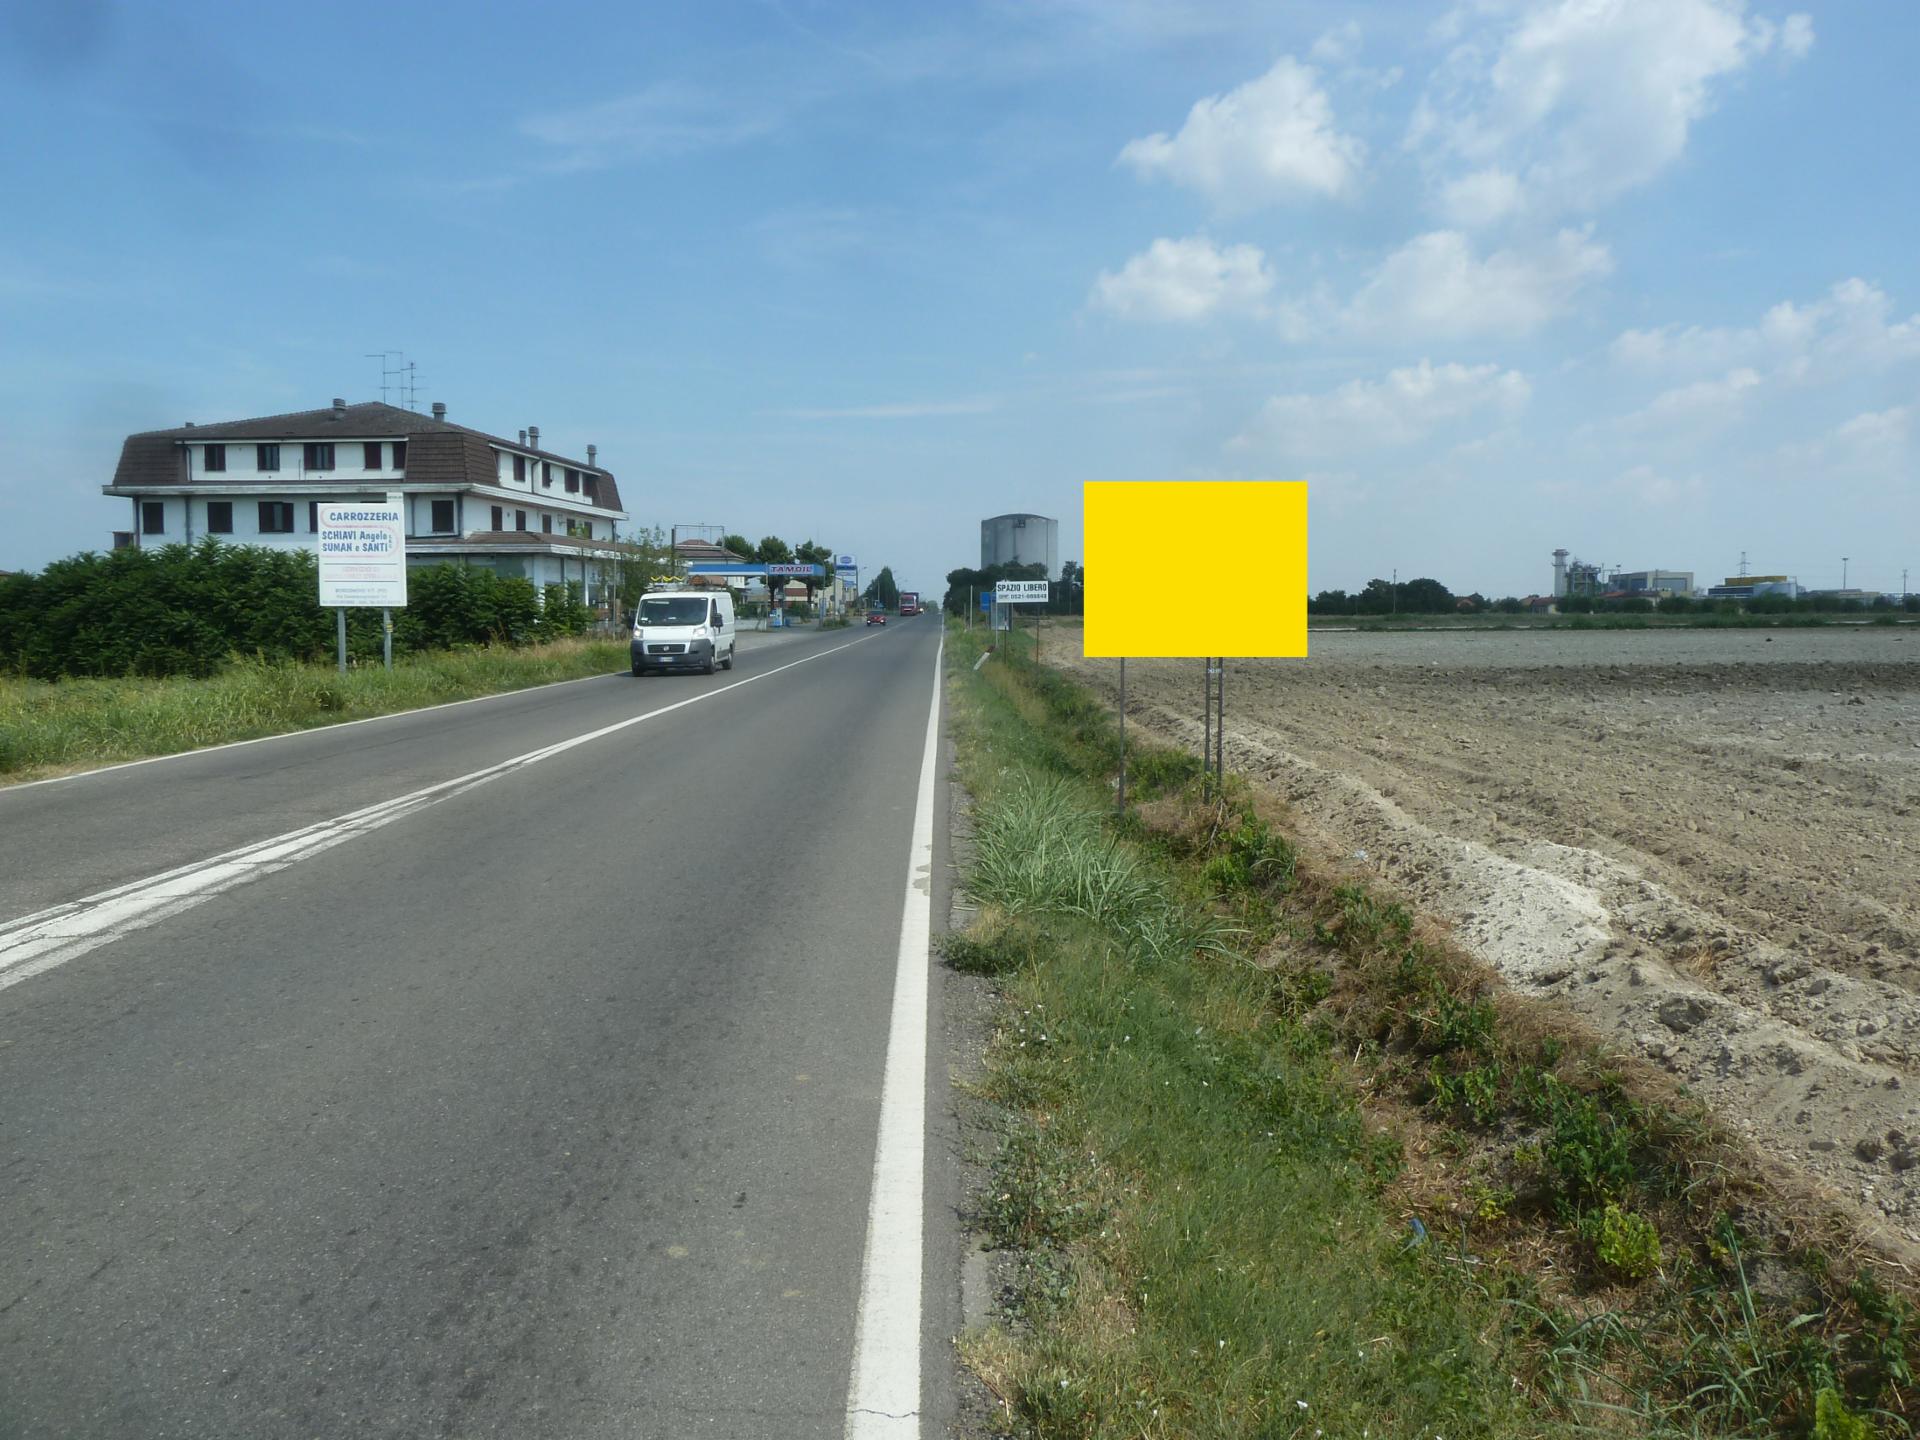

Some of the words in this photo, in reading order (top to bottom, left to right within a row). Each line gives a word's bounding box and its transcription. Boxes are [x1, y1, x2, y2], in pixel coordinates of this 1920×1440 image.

[330, 512, 399, 521] CARROZZERIA
[322, 530, 356, 540] SCHIAVI
[360, 530, 387, 542] Angelo
[322, 542, 353, 552] SUMAN
[362, 542, 388, 552] SANTI
